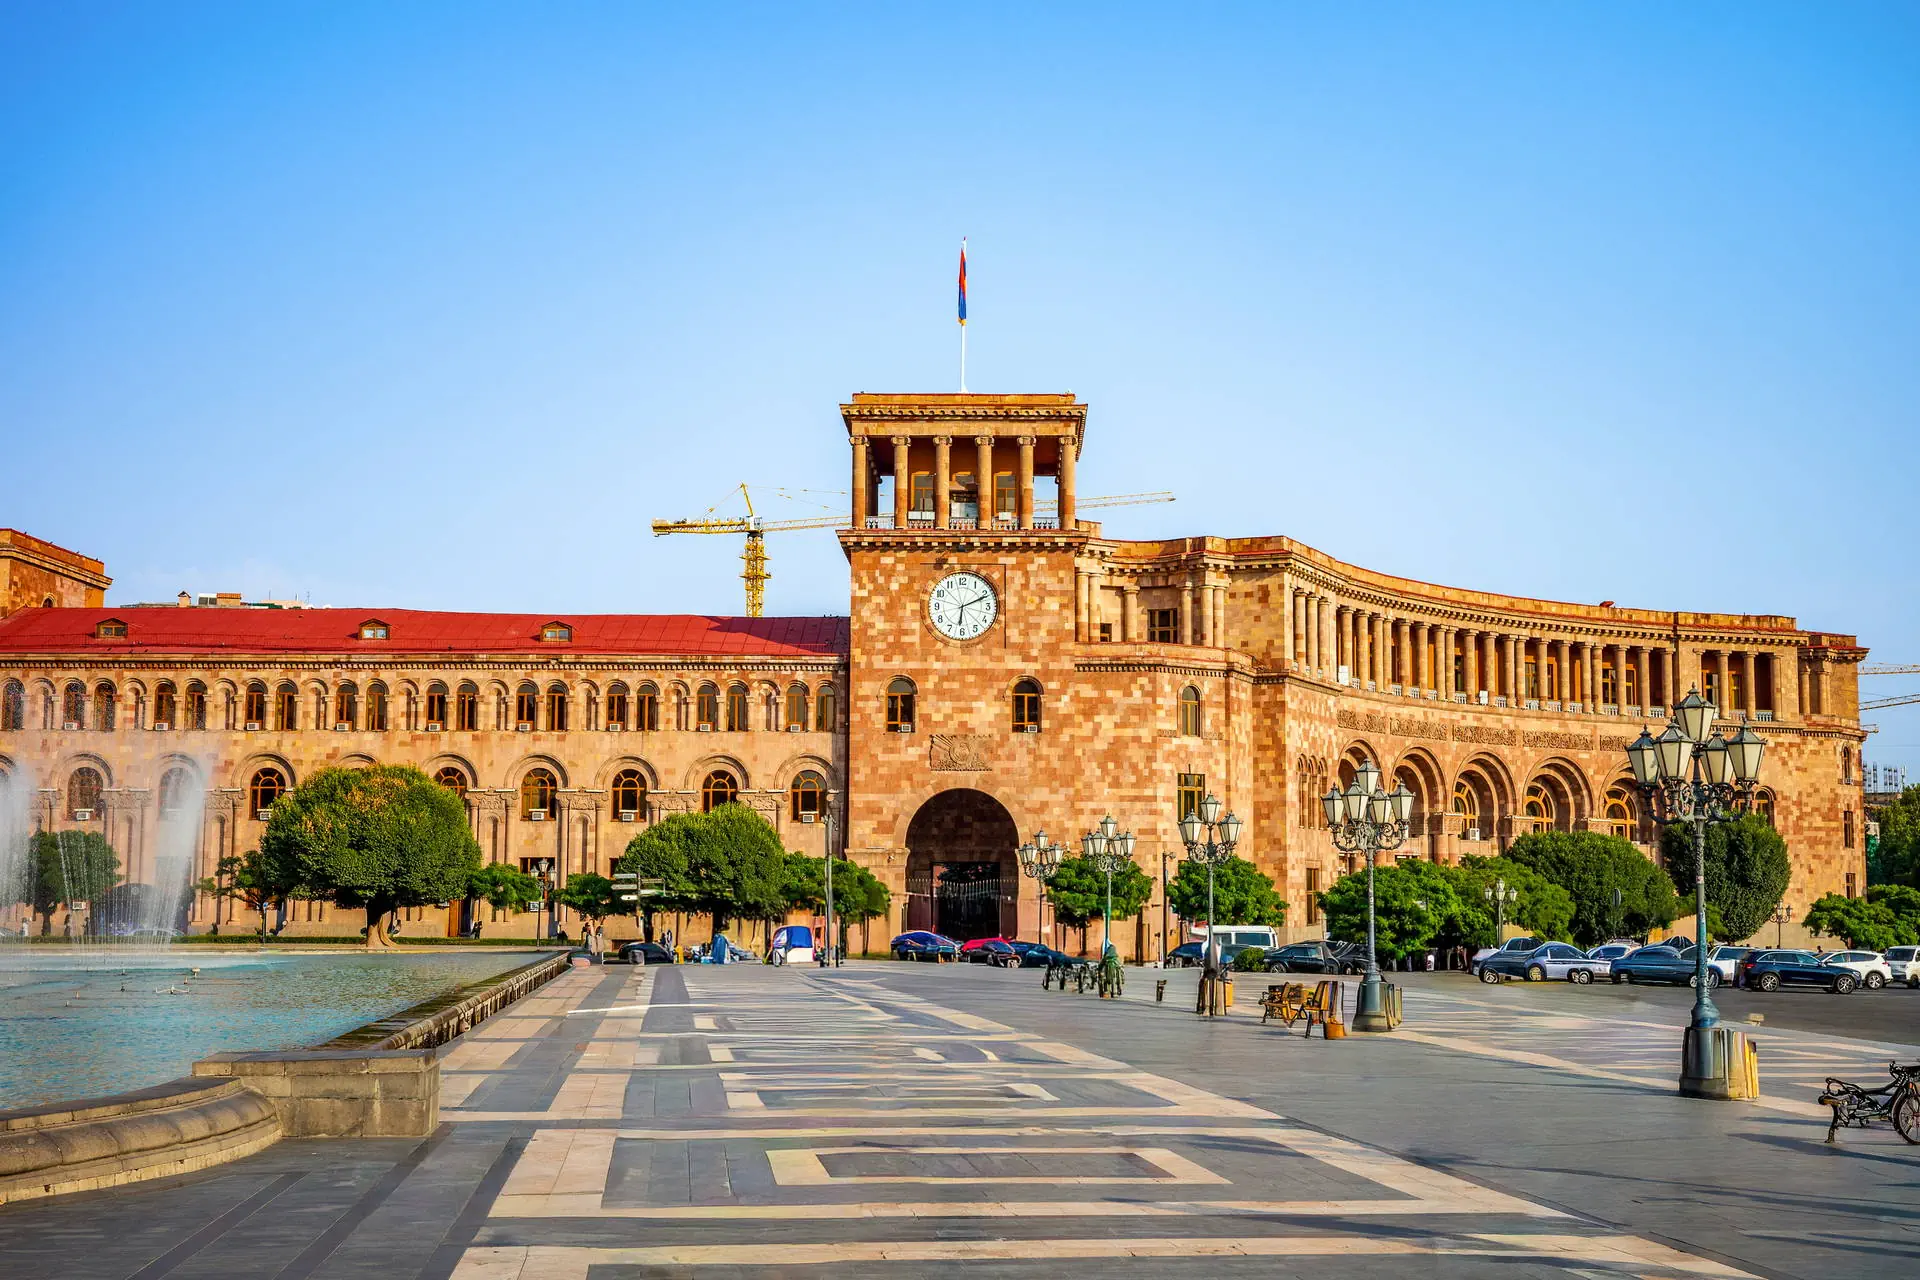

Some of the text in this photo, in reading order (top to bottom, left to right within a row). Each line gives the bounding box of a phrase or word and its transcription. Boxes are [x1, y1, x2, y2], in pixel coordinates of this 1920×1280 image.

[947, 580, 953, 589] 11
[958, 577, 967, 586] 12
[936, 589, 944, 598] 10
[982, 589, 988, 597] 2
[934, 602, 940, 611] 9
[985, 602, 991, 611] 3
[937, 615, 943, 623] 8
[982, 615, 987, 623] 4
[947, 624, 953, 632] 7
[959, 628, 965, 636] 6
[972, 625, 978, 633] 5
